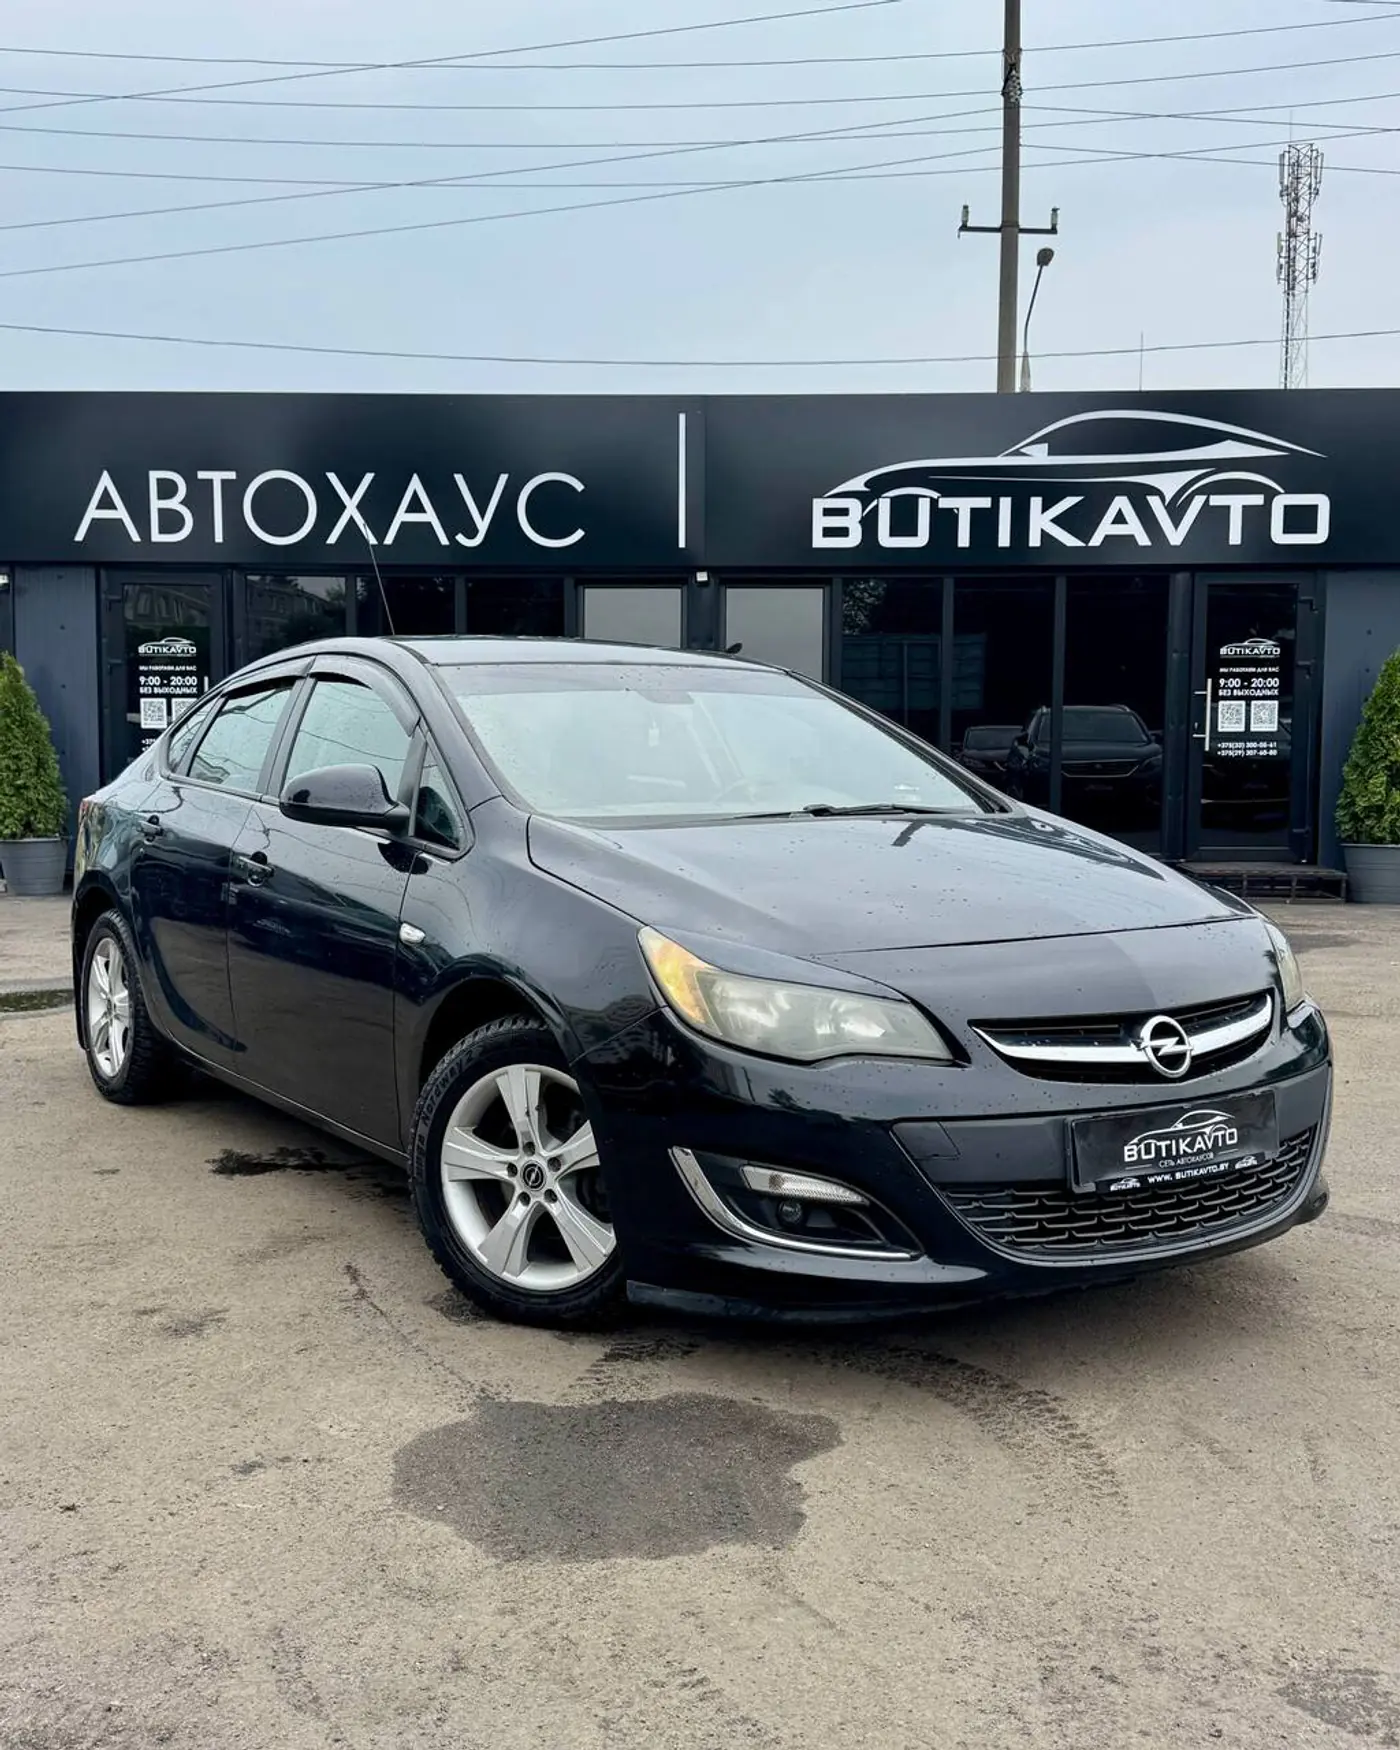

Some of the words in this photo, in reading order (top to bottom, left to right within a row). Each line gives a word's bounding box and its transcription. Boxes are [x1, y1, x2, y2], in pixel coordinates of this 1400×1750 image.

[74, 469, 586, 548] АВТОХАУС
[811, 493, 1330, 549] BUTIKAVTO
[138, 645, 197, 654] BUTIKAVTO
[1220, 647, 1280, 655] BUTIKAVTO
[139, 676, 161, 686] 9:00
[170, 676, 197, 686] 20:00
[1219, 678, 1241, 688] 9:00
[1251, 677, 1279, 688] 20:00
[154, 687, 197, 695] ВЫХОДНЫХ
[1218, 688, 1231, 696] БЕЗ
[1233, 688, 1279, 696] ВЫХОДНЫХ
[1124, 1128, 1238, 1162] BUTIKAVTO
[1175, 1162, 1229, 1179] BUTIKAVTO.BY
